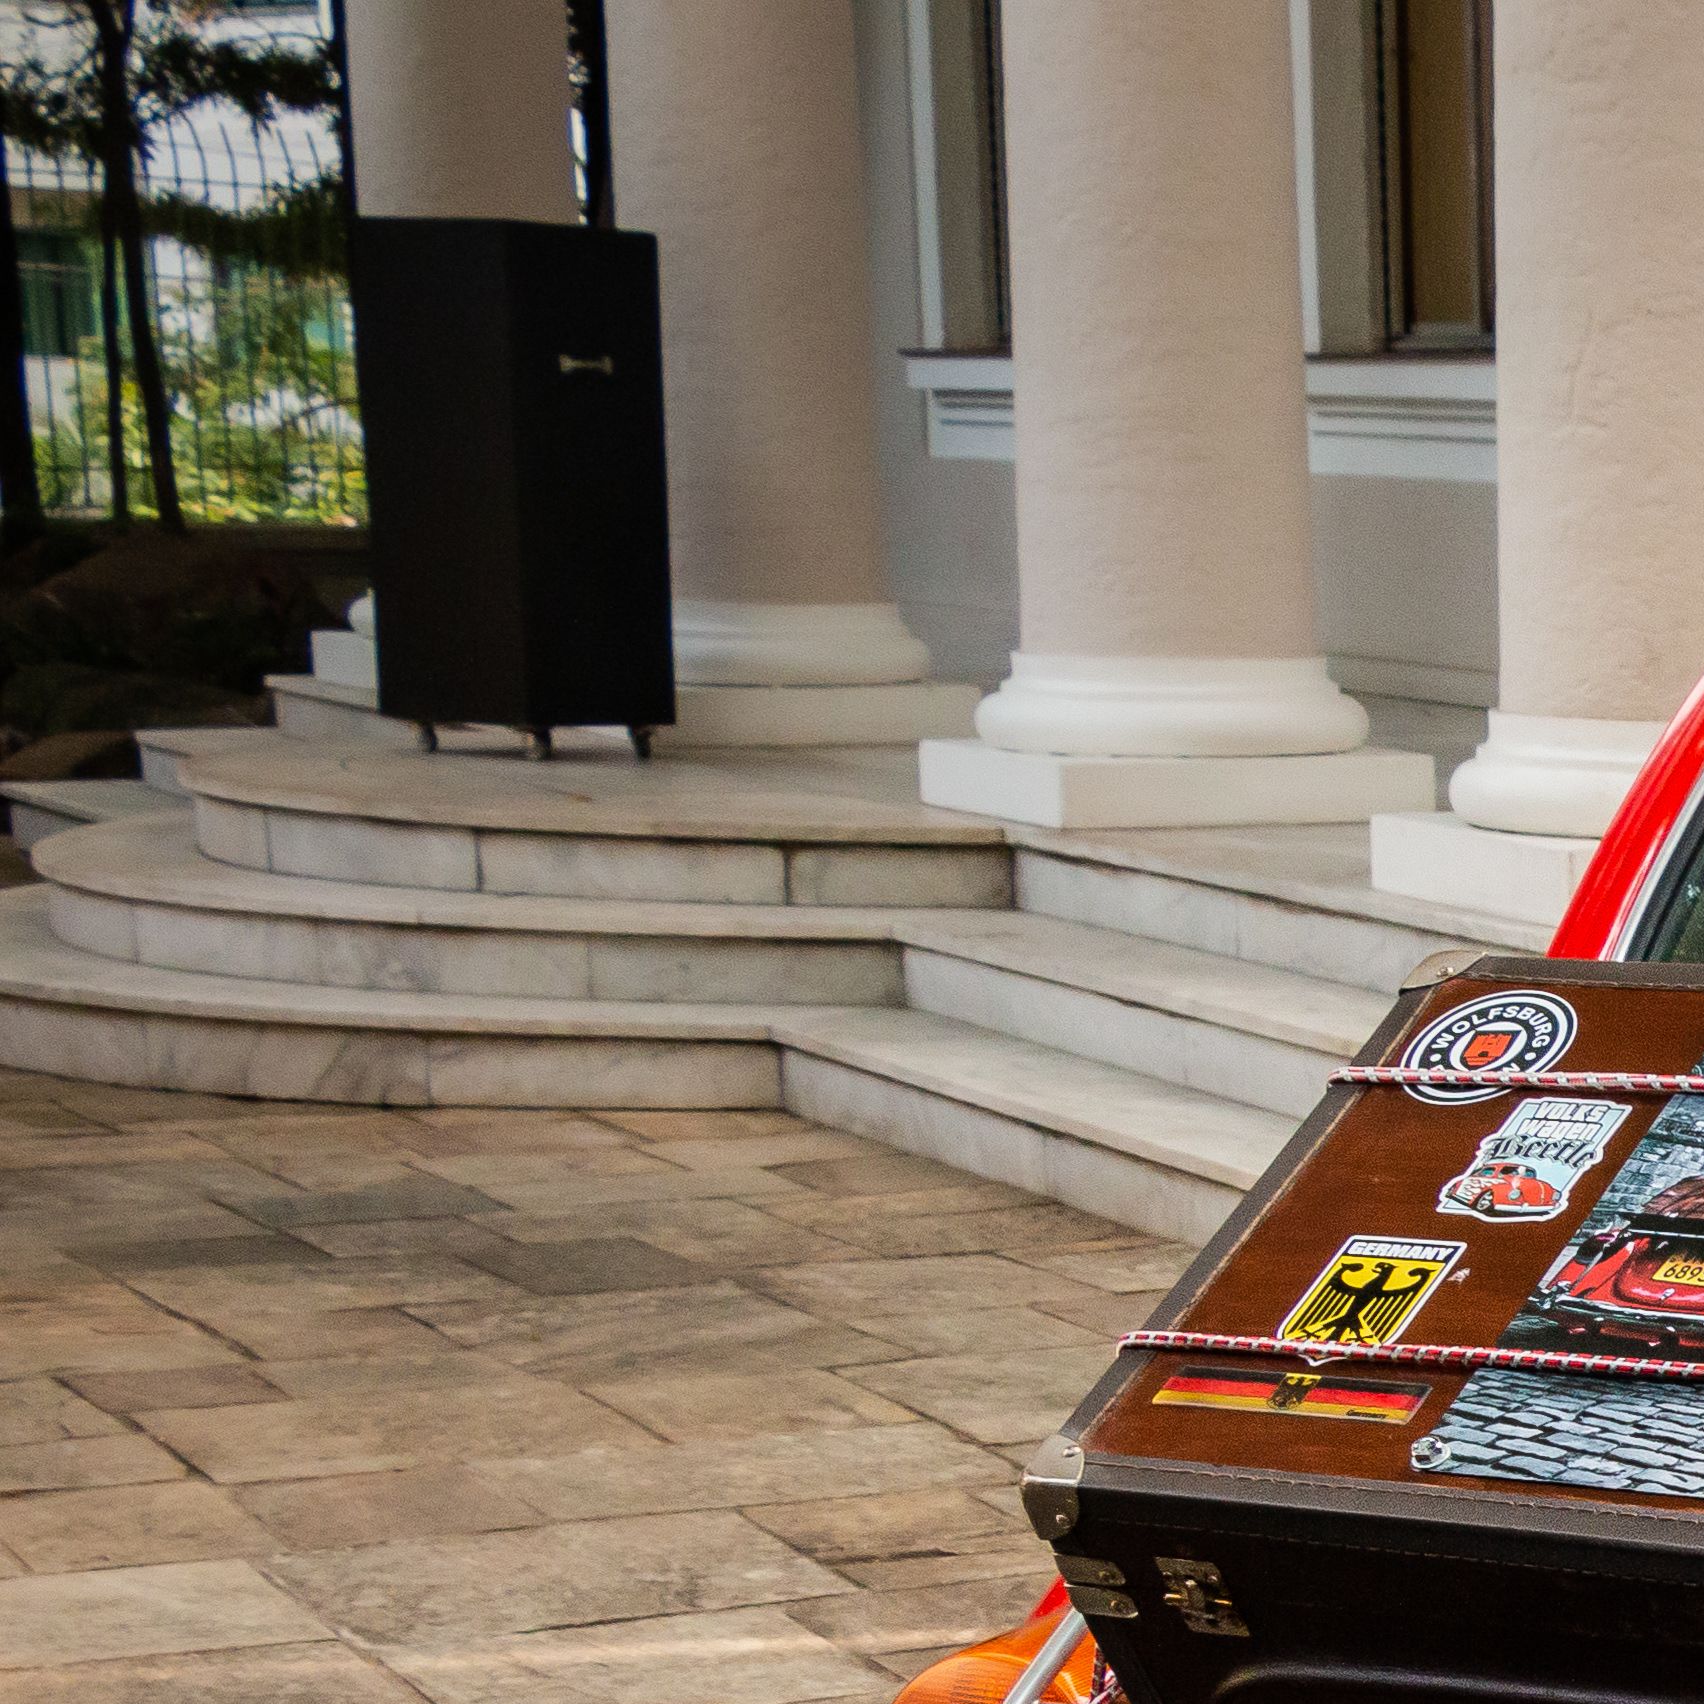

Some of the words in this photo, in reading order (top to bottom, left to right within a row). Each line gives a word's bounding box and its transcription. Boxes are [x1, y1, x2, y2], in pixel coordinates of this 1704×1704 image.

[1431, 1005, 1553, 1049] WOLFSBURG
[1534, 1101, 1609, 1122] VOLKS
[1484, 1134, 1597, 1168] Beetle
[1346, 1241, 1455, 1260] GERMANY
